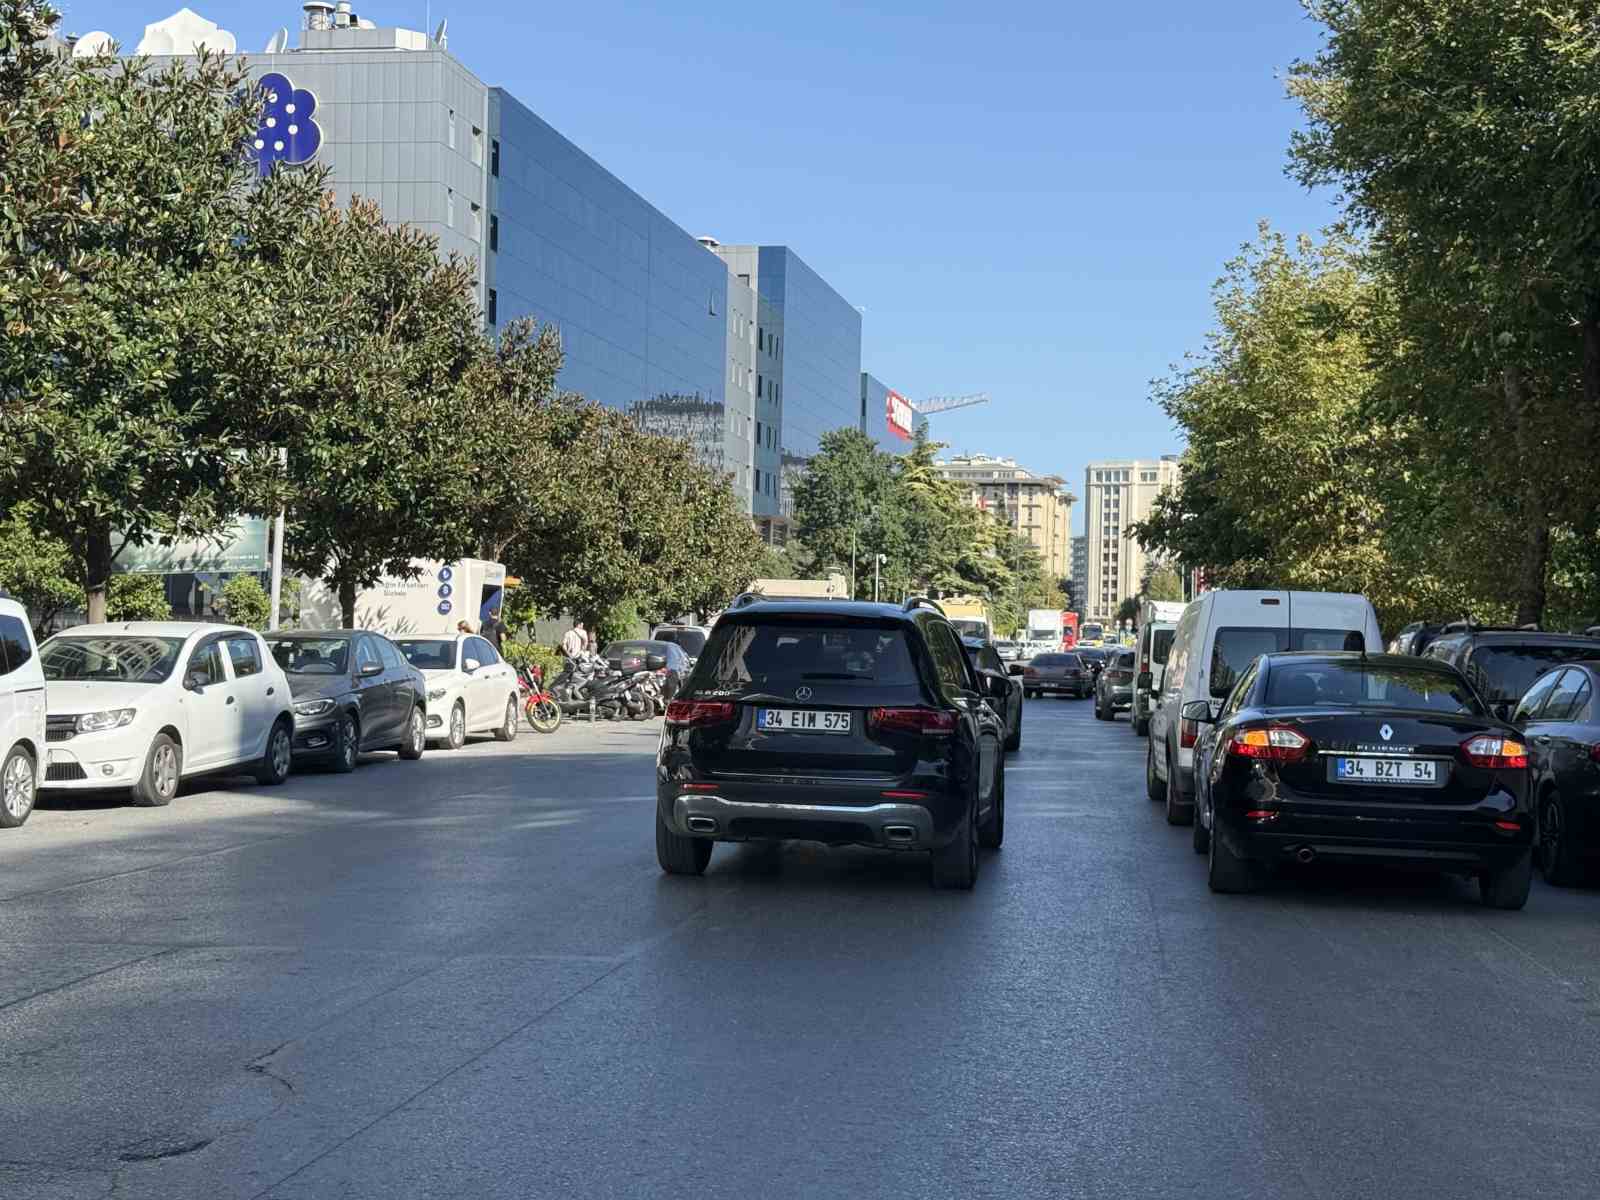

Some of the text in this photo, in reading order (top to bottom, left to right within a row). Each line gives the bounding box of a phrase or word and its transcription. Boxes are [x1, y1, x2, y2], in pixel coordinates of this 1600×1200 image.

[767, 711, 849, 729] 34 EIM 575
[1346, 760, 1364, 776] 34
[1375, 761, 1402, 776] BZT
[1414, 763, 1432, 778] 54
